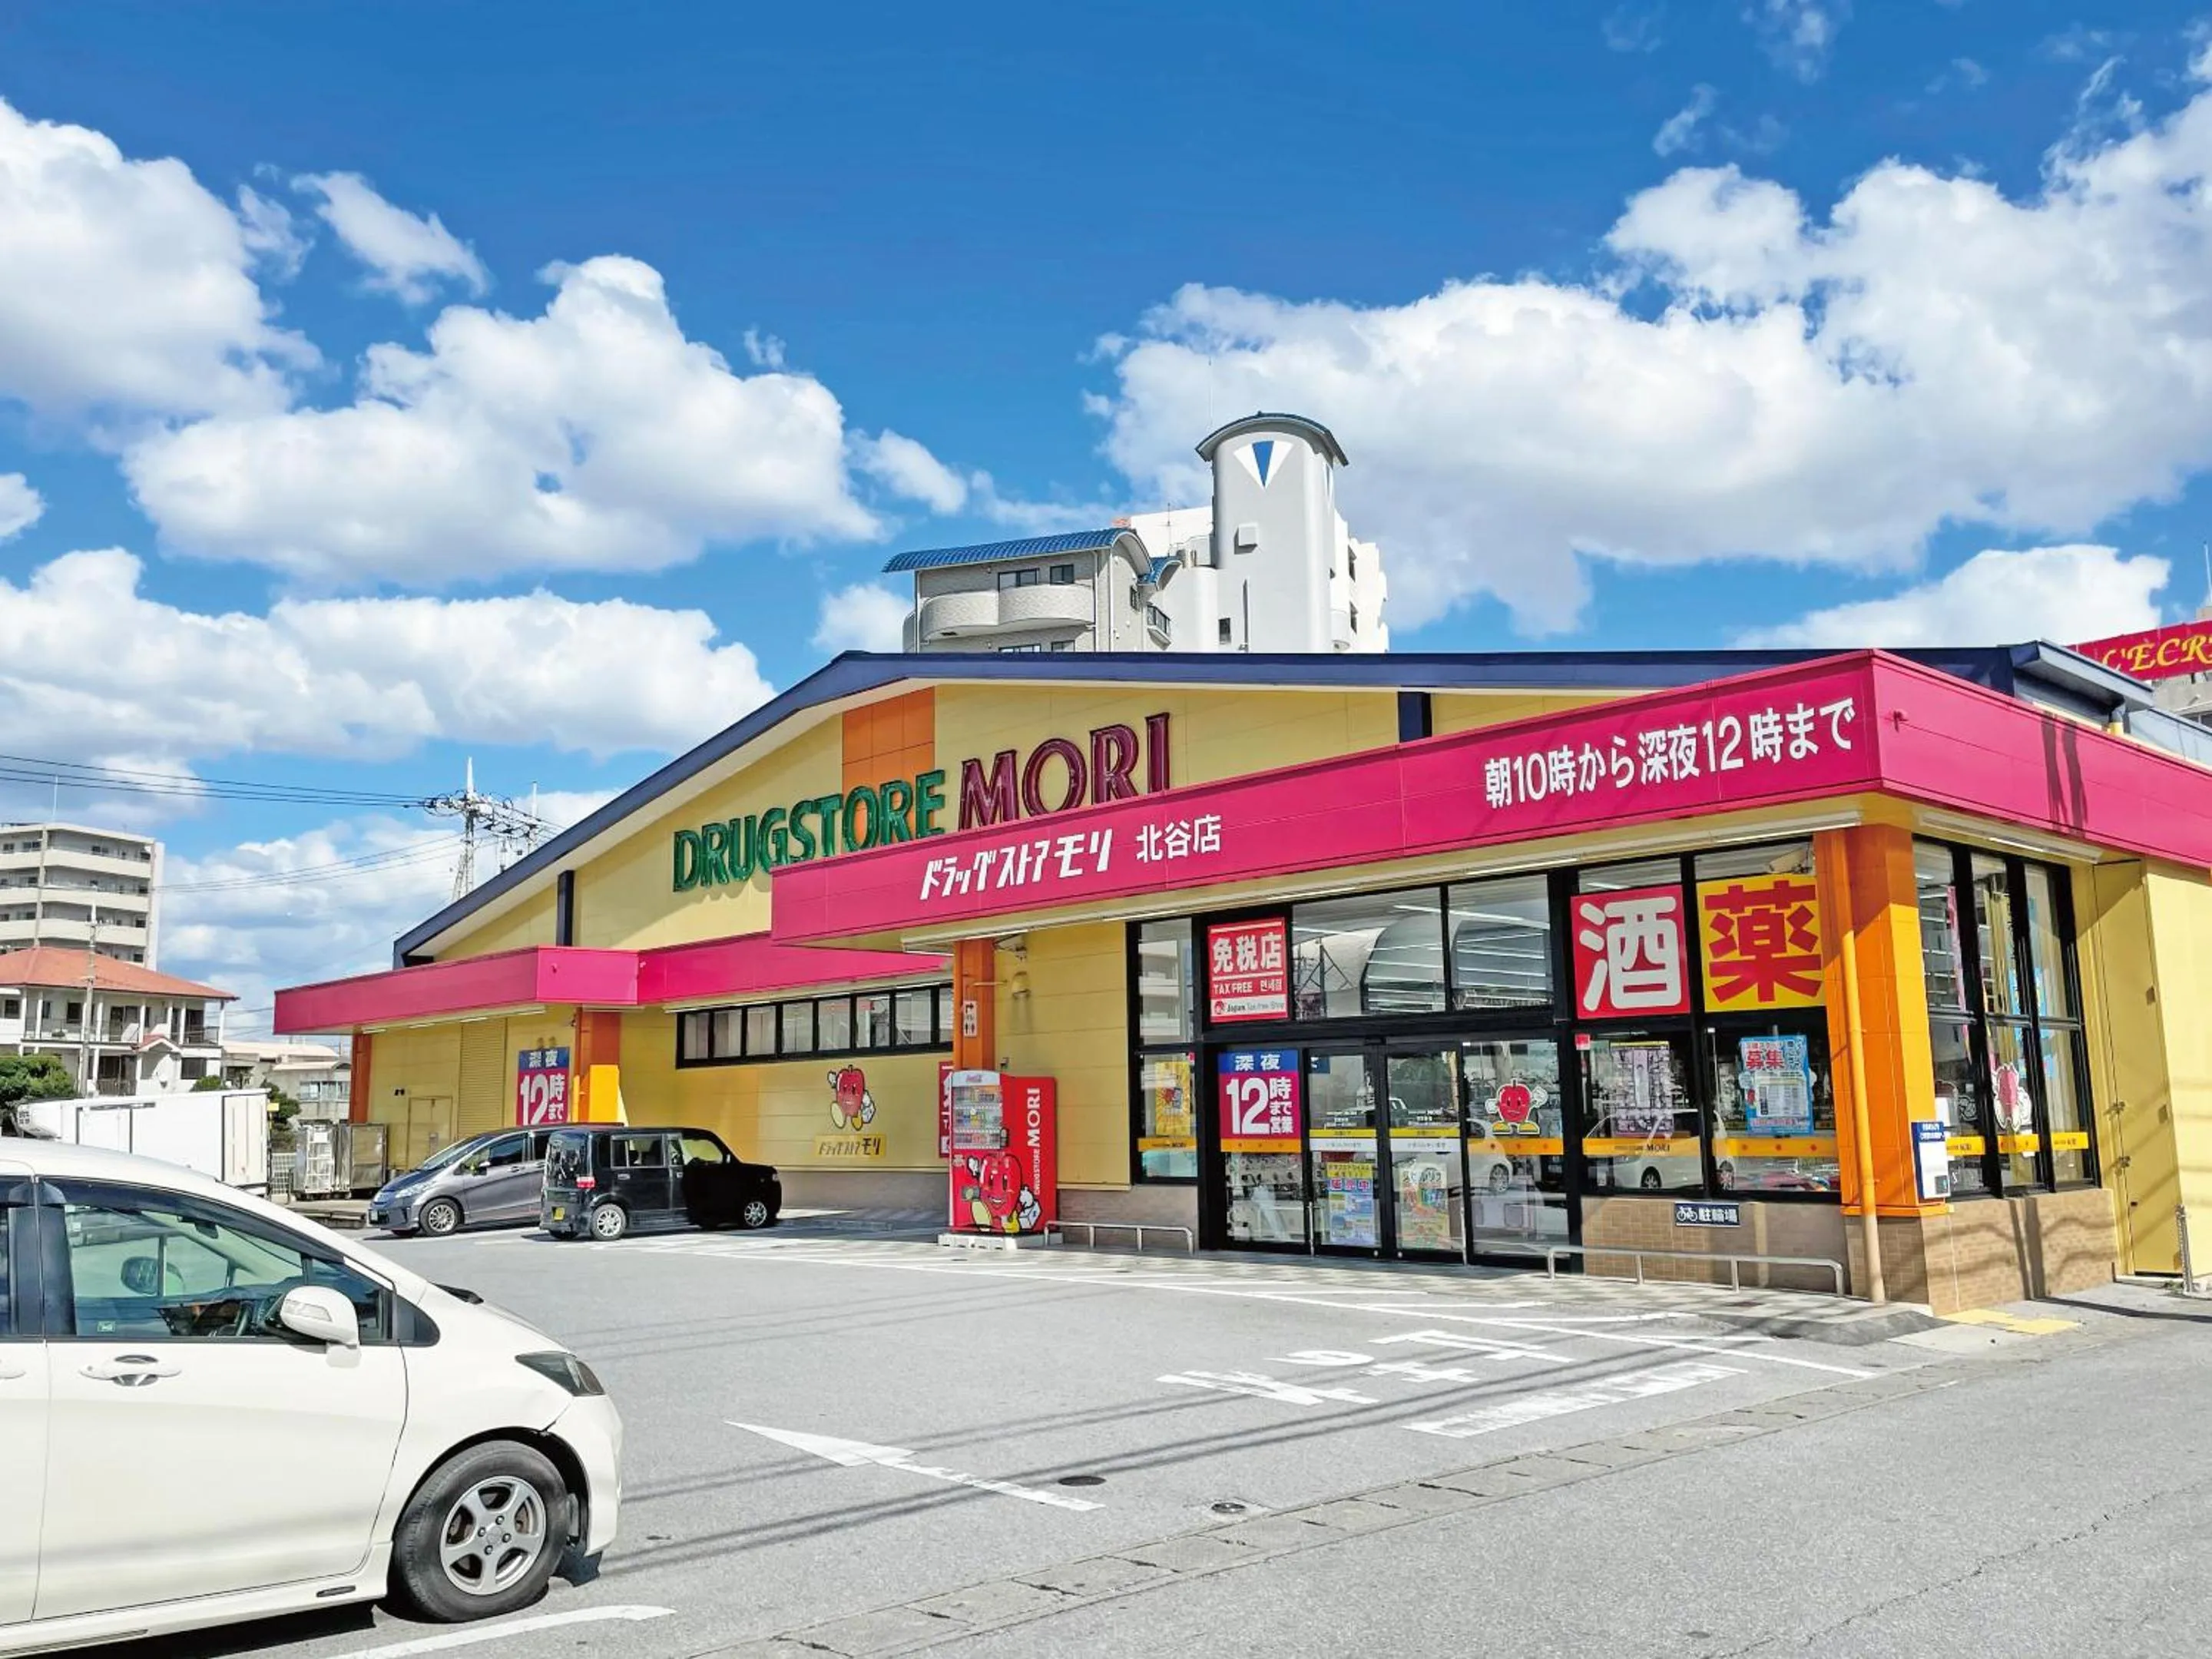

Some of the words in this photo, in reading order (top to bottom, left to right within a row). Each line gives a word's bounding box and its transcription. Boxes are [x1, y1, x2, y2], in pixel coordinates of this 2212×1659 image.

[1485, 697, 1856, 809] 朝10時から深夜12時まで
[673, 769, 945, 892] DRUGSTORE
[959, 712, 1171, 831] MORI
[920, 828, 1113, 900] ドラッグストアモリ
[1136, 815, 1222, 863] 北谷店
[1213, 932, 1282, 974] 免税店
[1578, 895, 1683, 1012] 酒
[1704, 879, 1823, 1003] 薬
[1214, 984, 1230, 995] TAX
[1232, 982, 1253, 994] FREE
[529, 1050, 558, 1068] 深夜
[1235, 1054, 1281, 1071] 深夜
[520, 1074, 548, 1126] 12
[1027, 1088, 1041, 1147] MORI
[1226, 1077, 1270, 1134] 12
[1270, 1101, 1293, 1116] まで
[1698, 1207, 1737, 1224] 駐輪場
